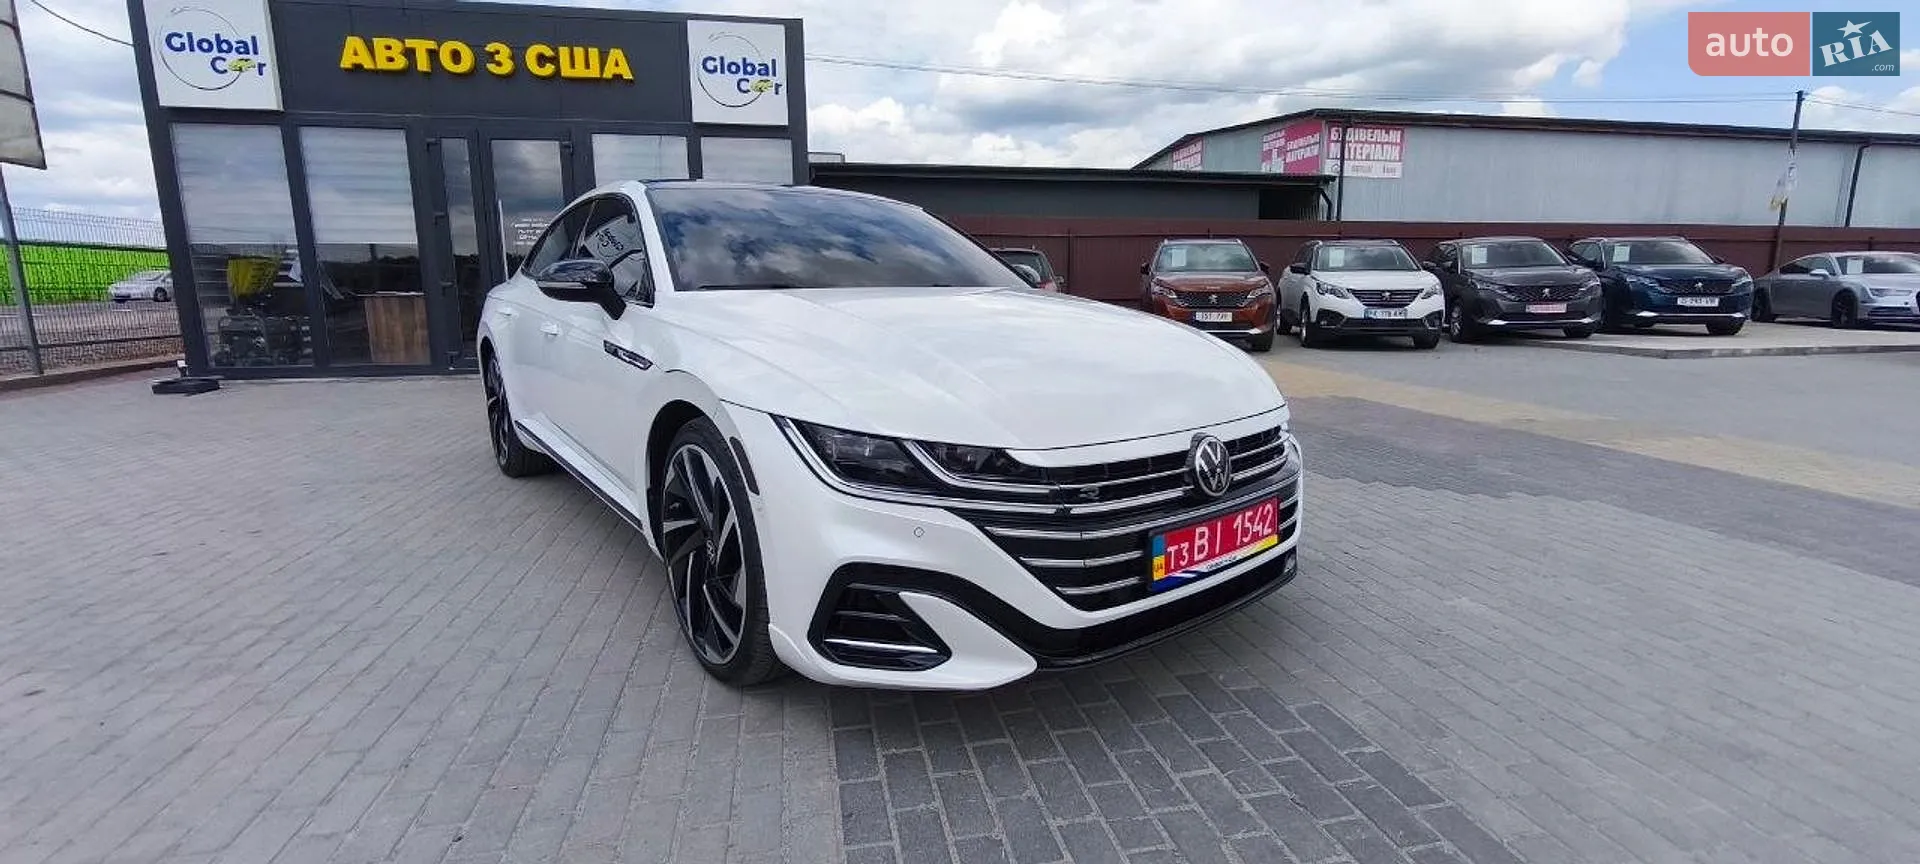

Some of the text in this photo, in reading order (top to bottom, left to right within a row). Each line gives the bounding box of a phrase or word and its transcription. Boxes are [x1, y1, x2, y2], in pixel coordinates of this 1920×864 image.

[164, 31, 260, 56] Global
[209, 55, 267, 76] Cr
[340, 36, 476, 75] АВТО
[524, 43, 635, 81] США
[702, 55, 777, 77] Global
[736, 77, 783, 96] Cr
[1233, 502, 1274, 546] 1542
